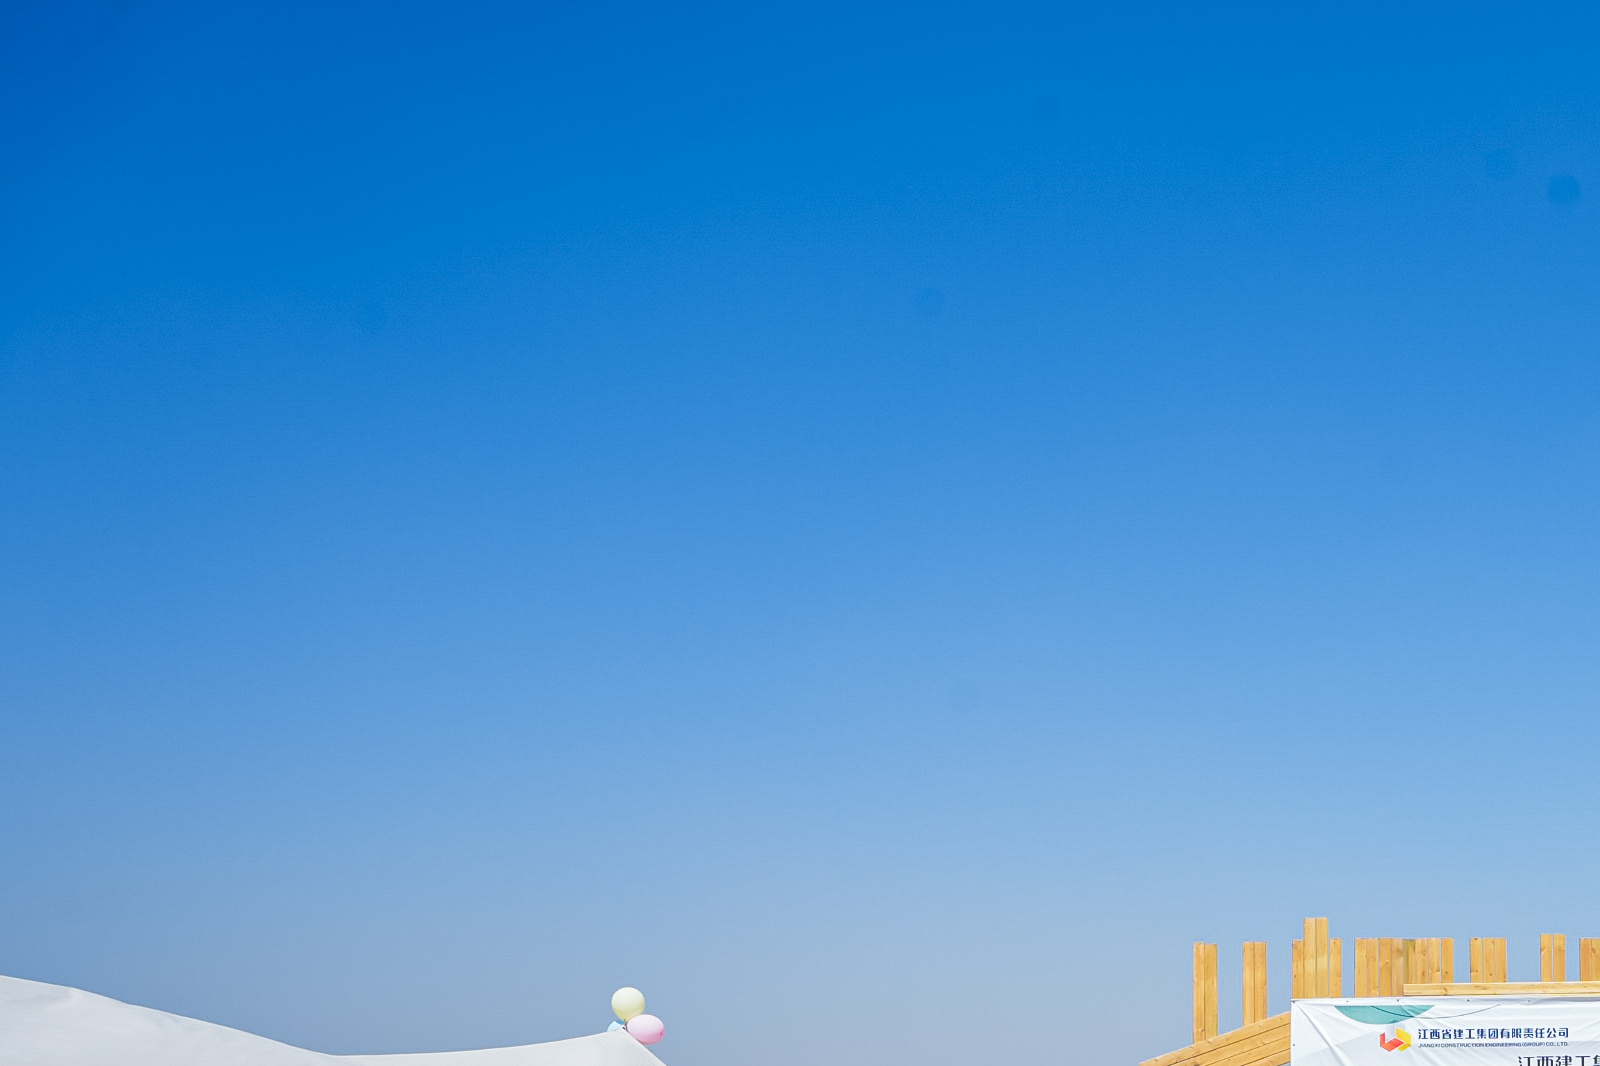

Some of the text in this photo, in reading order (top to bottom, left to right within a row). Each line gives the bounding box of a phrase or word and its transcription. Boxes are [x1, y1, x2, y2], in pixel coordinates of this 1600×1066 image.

[1418, 1027, 1569, 1040] 江西省建工集团有限责任公司
